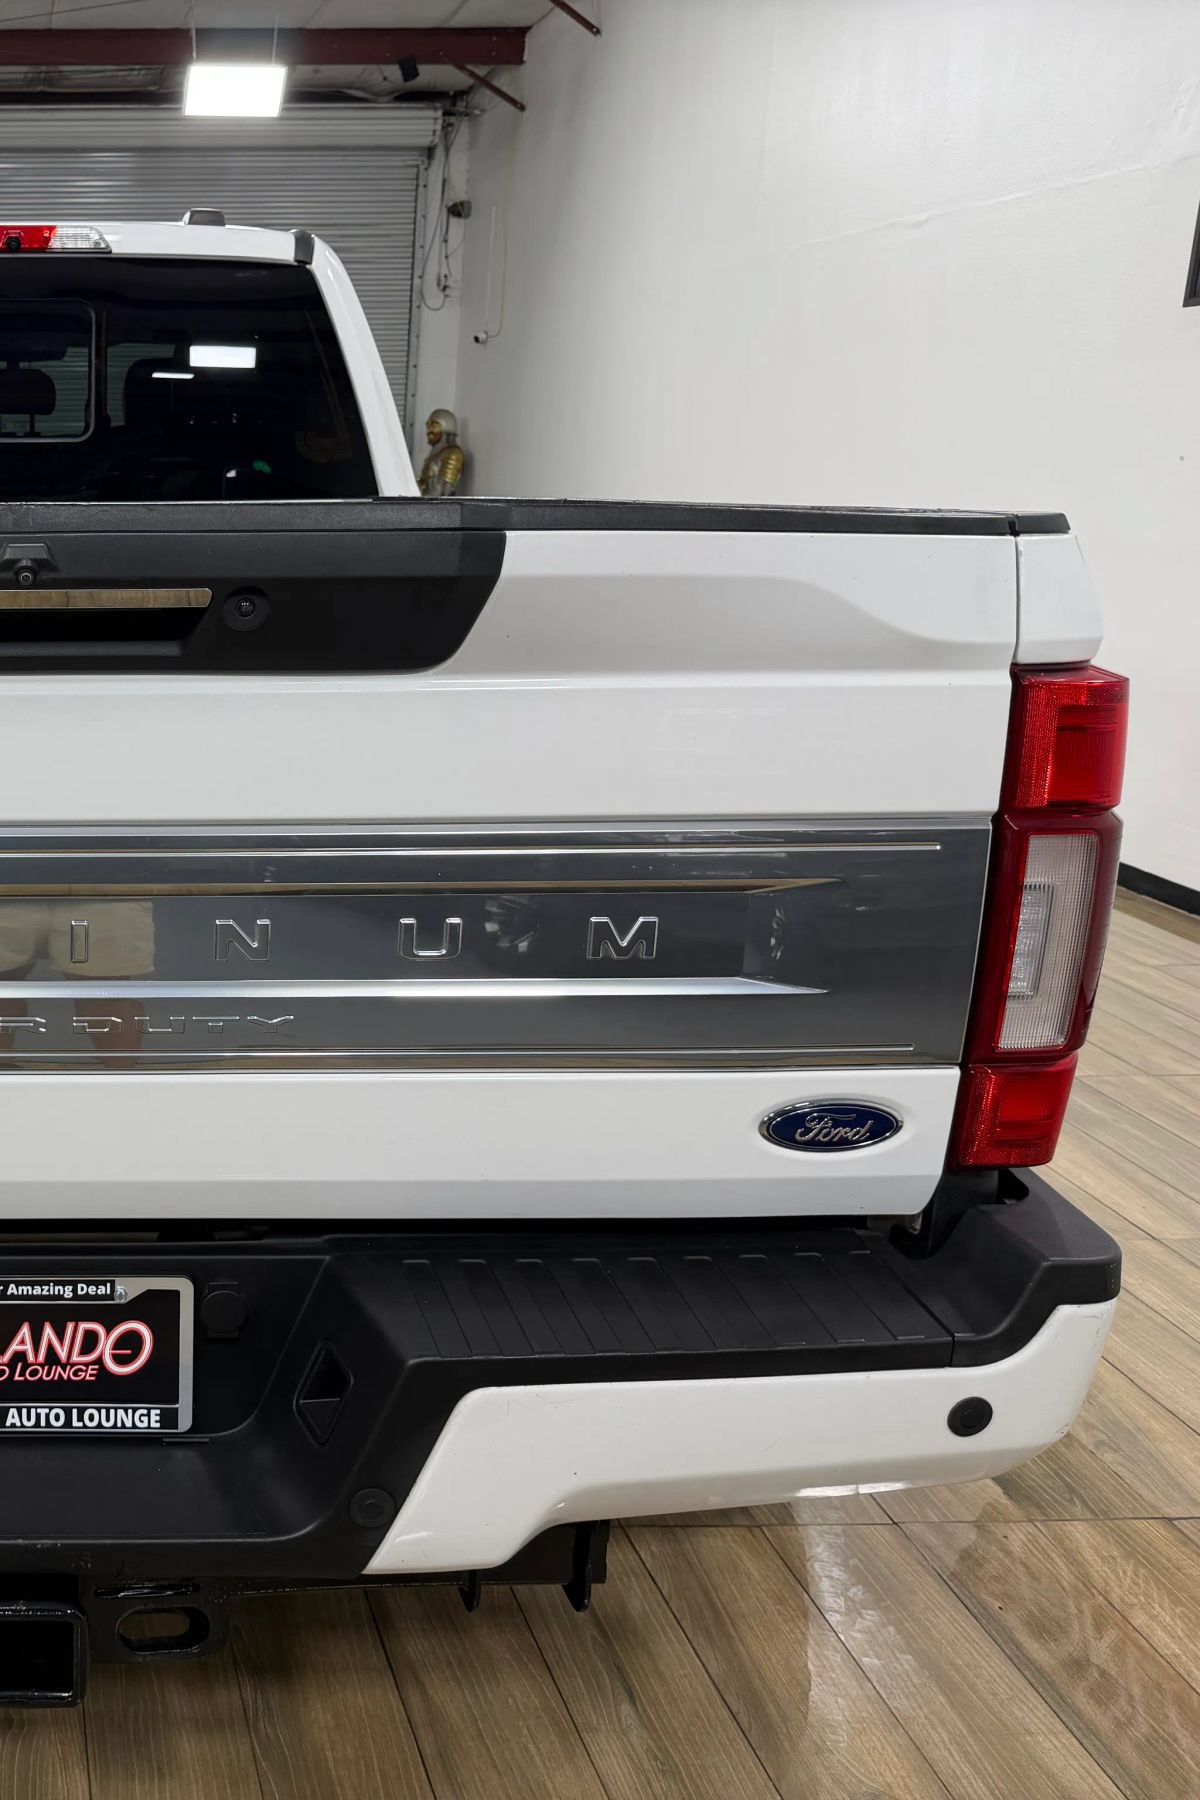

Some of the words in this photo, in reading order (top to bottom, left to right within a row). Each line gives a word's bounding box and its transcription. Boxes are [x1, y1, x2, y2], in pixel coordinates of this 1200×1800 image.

[72, 1015, 295, 1035] DUTY
[794, 1112, 875, 1142] Ford
[6, 1283, 73, 1298] Amazing
[76, 1282, 112, 1296] Deal
[13, 1362, 99, 1382] LOUNGE
[5, 1407, 66, 1429] AUTO
[71, 1407, 162, 1429] LOUNGE
